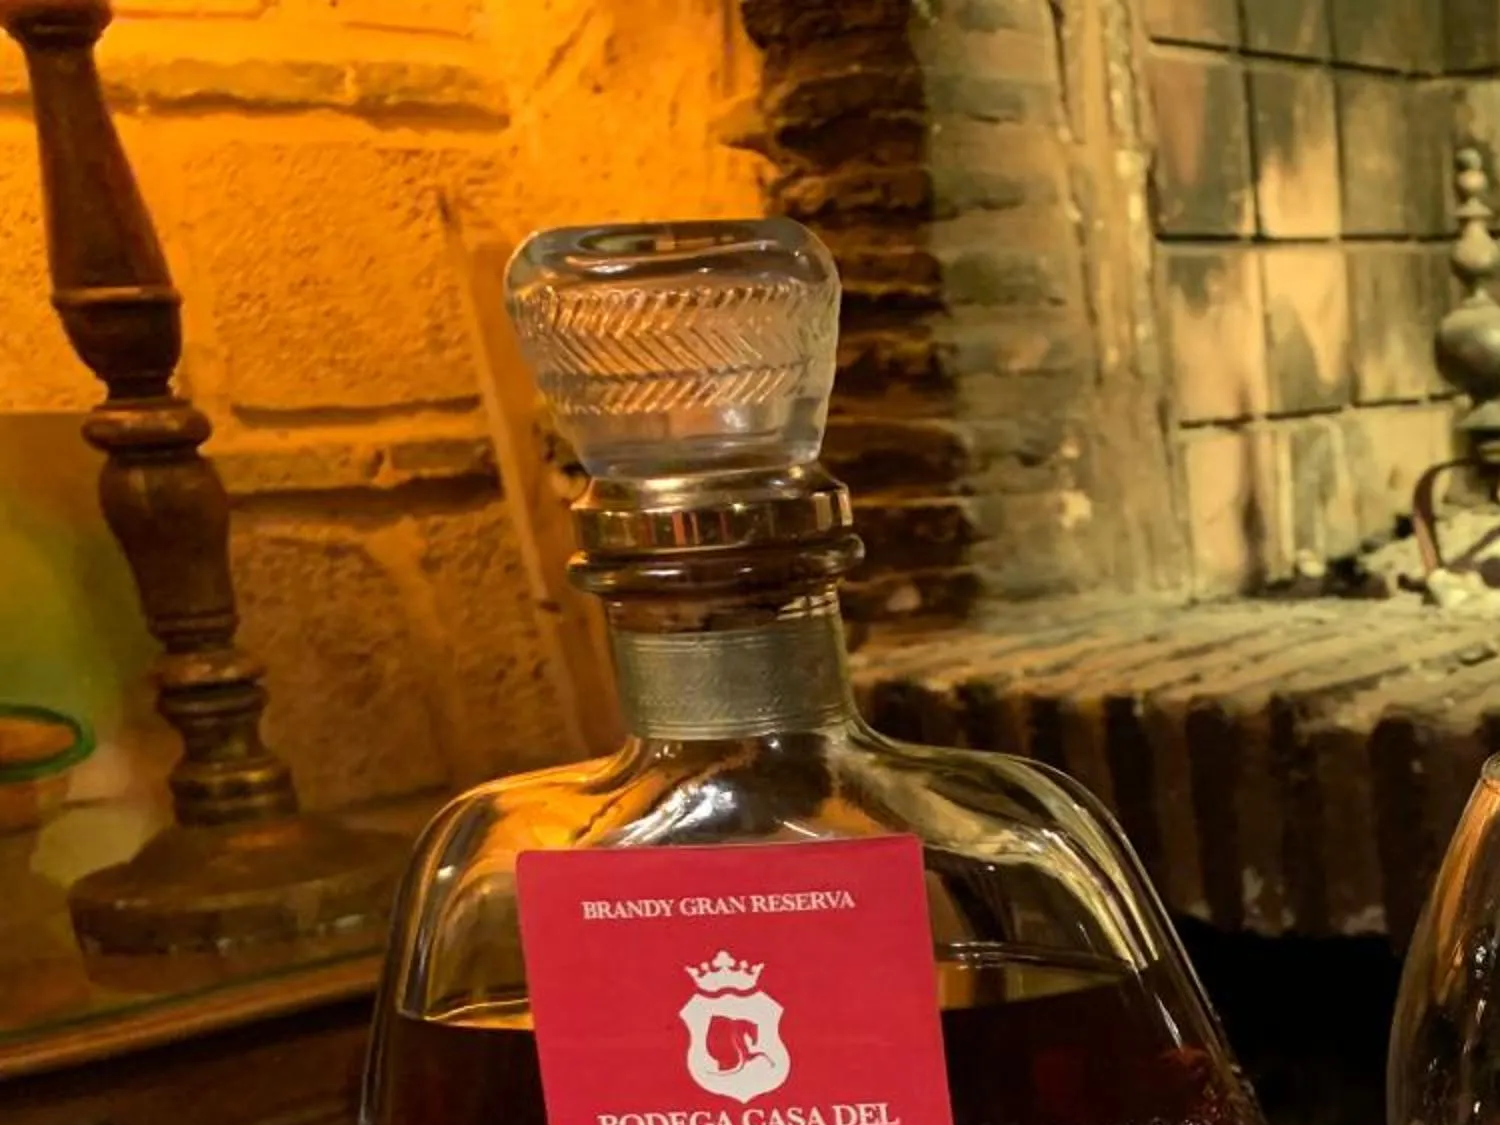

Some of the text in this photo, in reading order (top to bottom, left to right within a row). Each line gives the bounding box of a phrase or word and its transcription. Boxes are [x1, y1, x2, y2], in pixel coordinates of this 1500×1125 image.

[582, 891, 856, 920] BRANDY GRAN RESERVA
